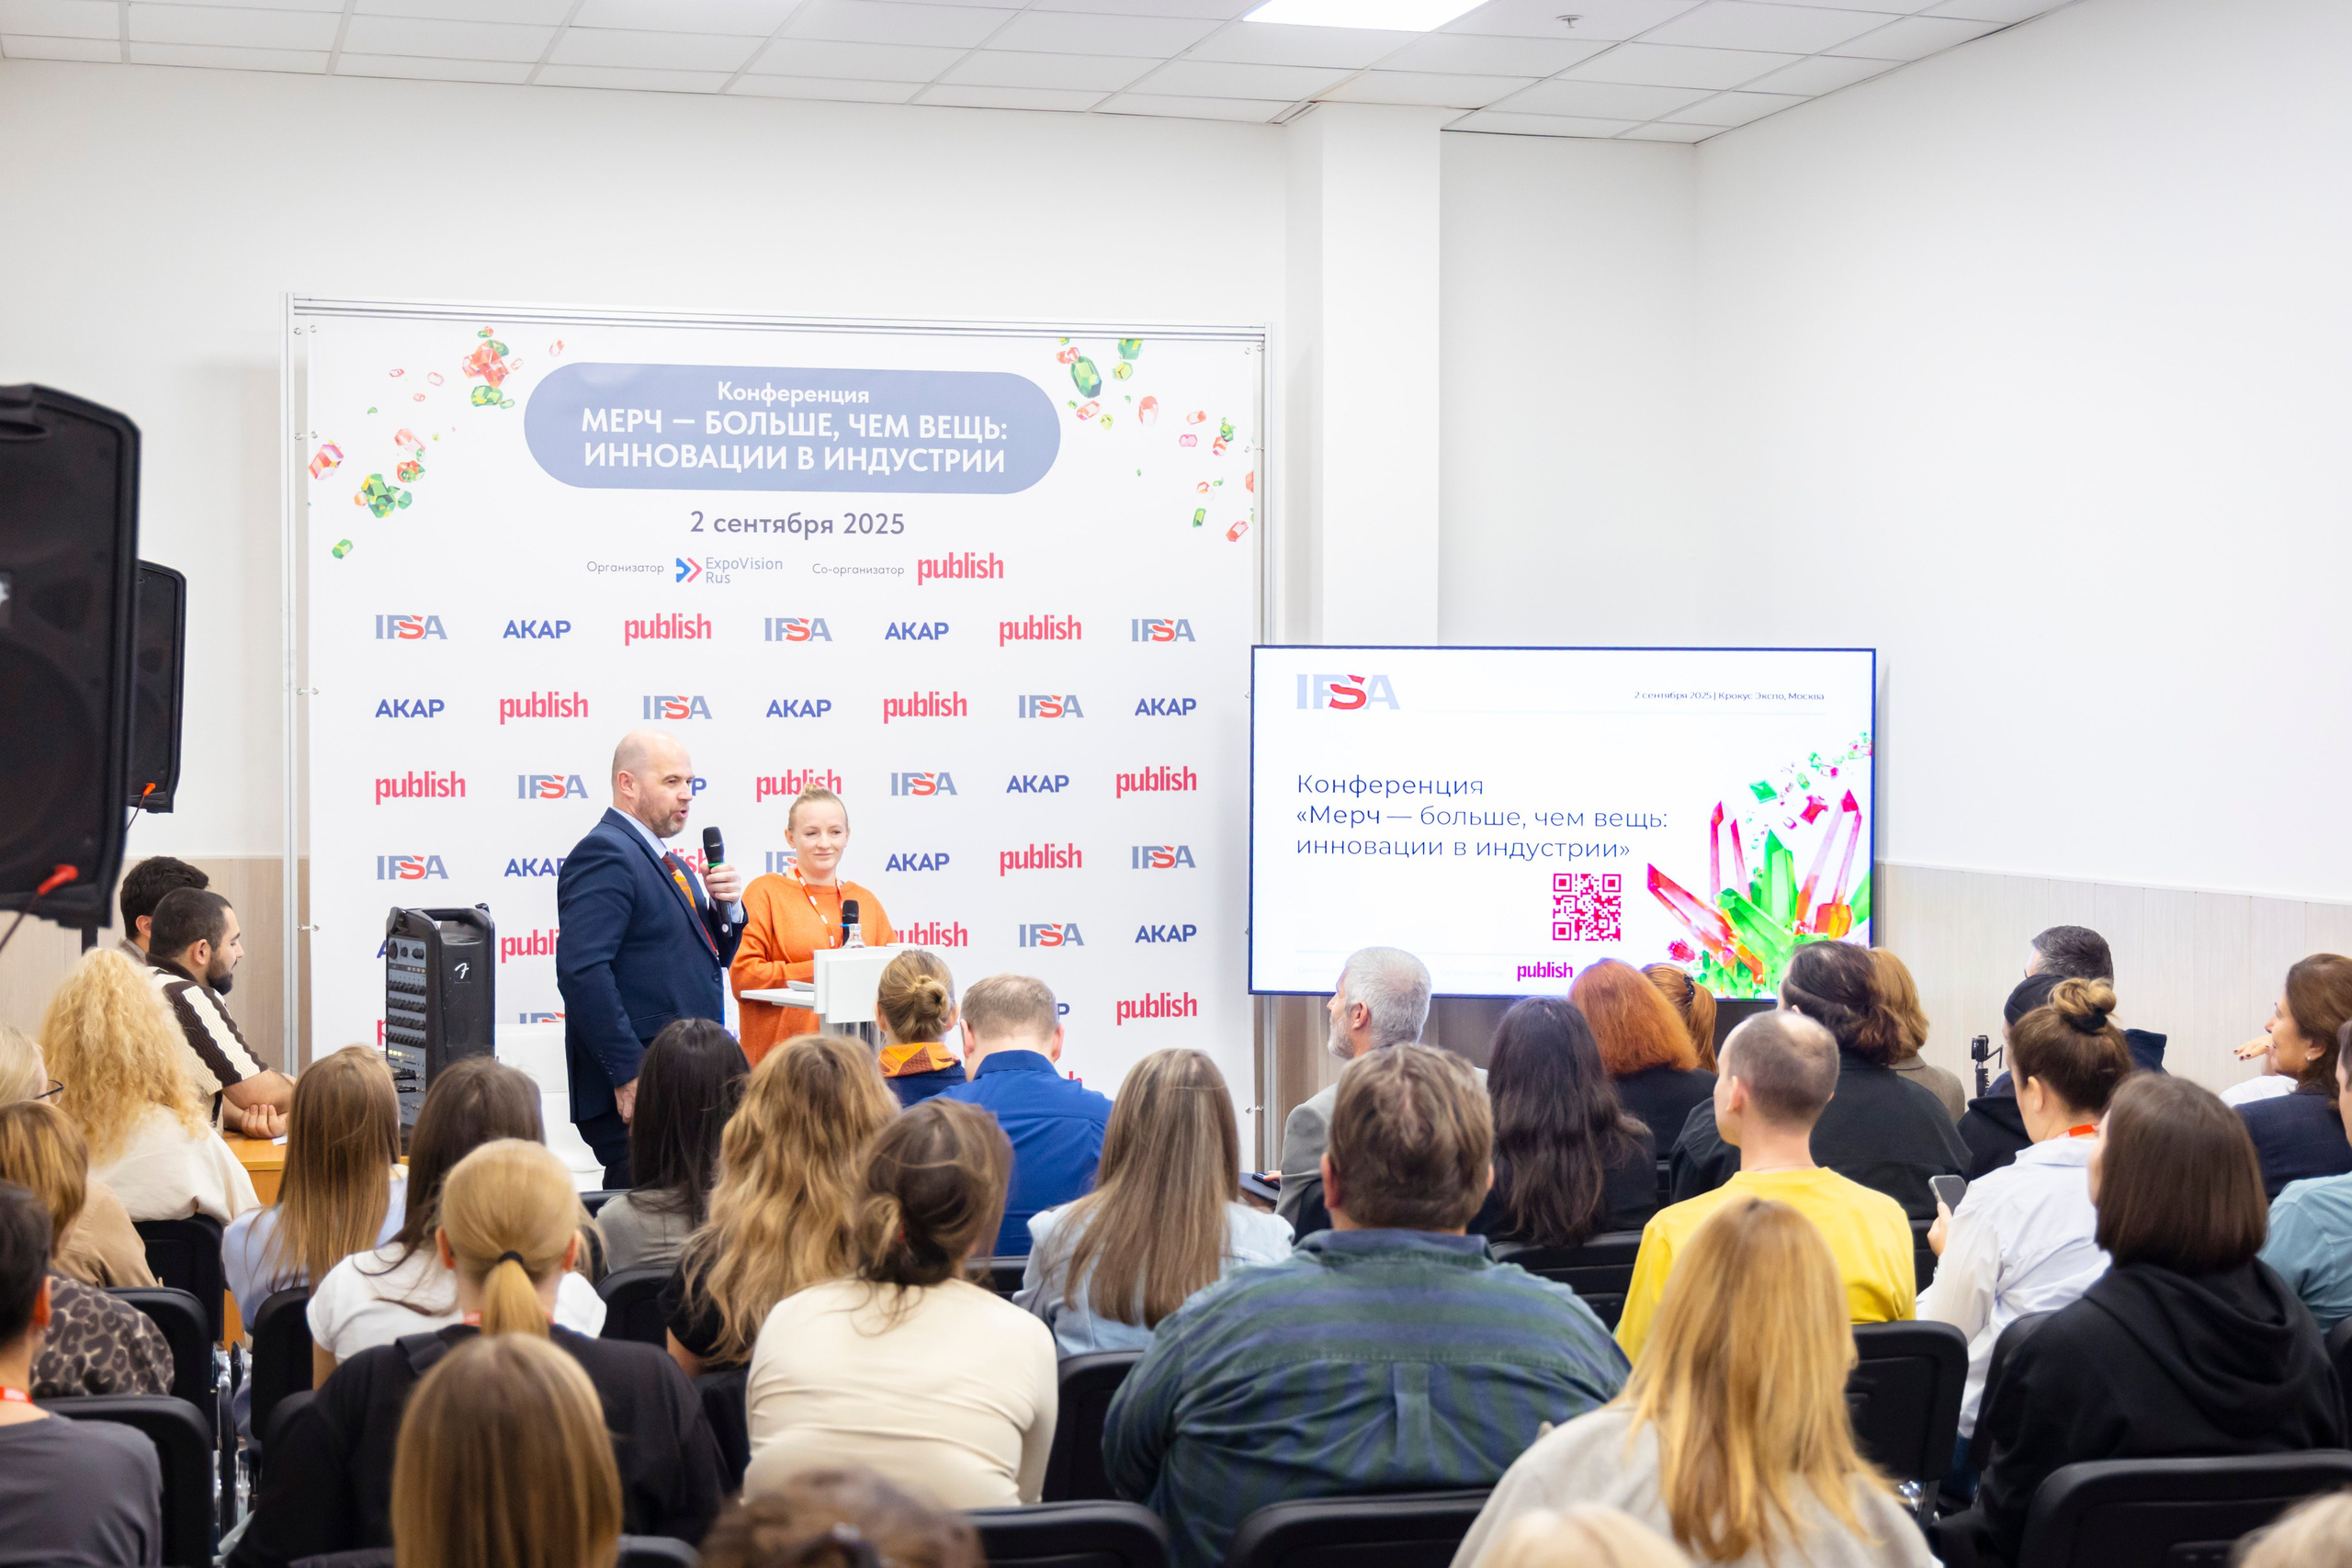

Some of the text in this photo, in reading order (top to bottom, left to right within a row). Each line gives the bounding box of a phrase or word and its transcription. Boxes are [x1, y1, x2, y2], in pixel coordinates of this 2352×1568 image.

[718, 380, 870, 406] Конференция
[582, 409, 662, 432] МЕРЧ
[706, 411, 840, 441] БОЛЬШЕ,
[849, 414, 909, 437] ЧЕМ
[919, 415, 1007, 443] ВЕЩЬ:
[584, 443, 1004, 475] ИННОВАЦИИ В ИНДУСТРИИ
[691, 511, 904, 540] 2 сентября 2025
[587, 561, 664, 575] Организатор
[707, 558, 782, 571] ExpoVision
[707, 571, 730, 583] Rus
[812, 563, 904, 577] Со-организатор
[918, 552, 1003, 585] publish
[625, 613, 711, 646] publish
[1000, 615, 1081, 647] publish
[500, 692, 588, 725] publish
[884, 692, 967, 724] publish
[1642, 692, 1688, 700] сентября
[1690, 692, 1712, 700] 2025
[1718, 692, 1753, 701] Крокус
[376, 771, 465, 805] publish
[1116, 766, 1196, 798] publish
[1299, 774, 1482, 798] Конференция
[1297, 806, 1379, 827] «Мерч
[1421, 806, 1525, 829] больше,
[1535, 813, 1583, 826] чем
[1595, 813, 1667, 829] вещь:
[1001, 843, 1081, 876] publish
[1298, 840, 1629, 862] инновации в индустрии»
[501, 929, 560, 964] publ
[894, 921, 967, 947] ublish
[1518, 962, 1573, 981] publish
[1117, 992, 1197, 1025] publish
